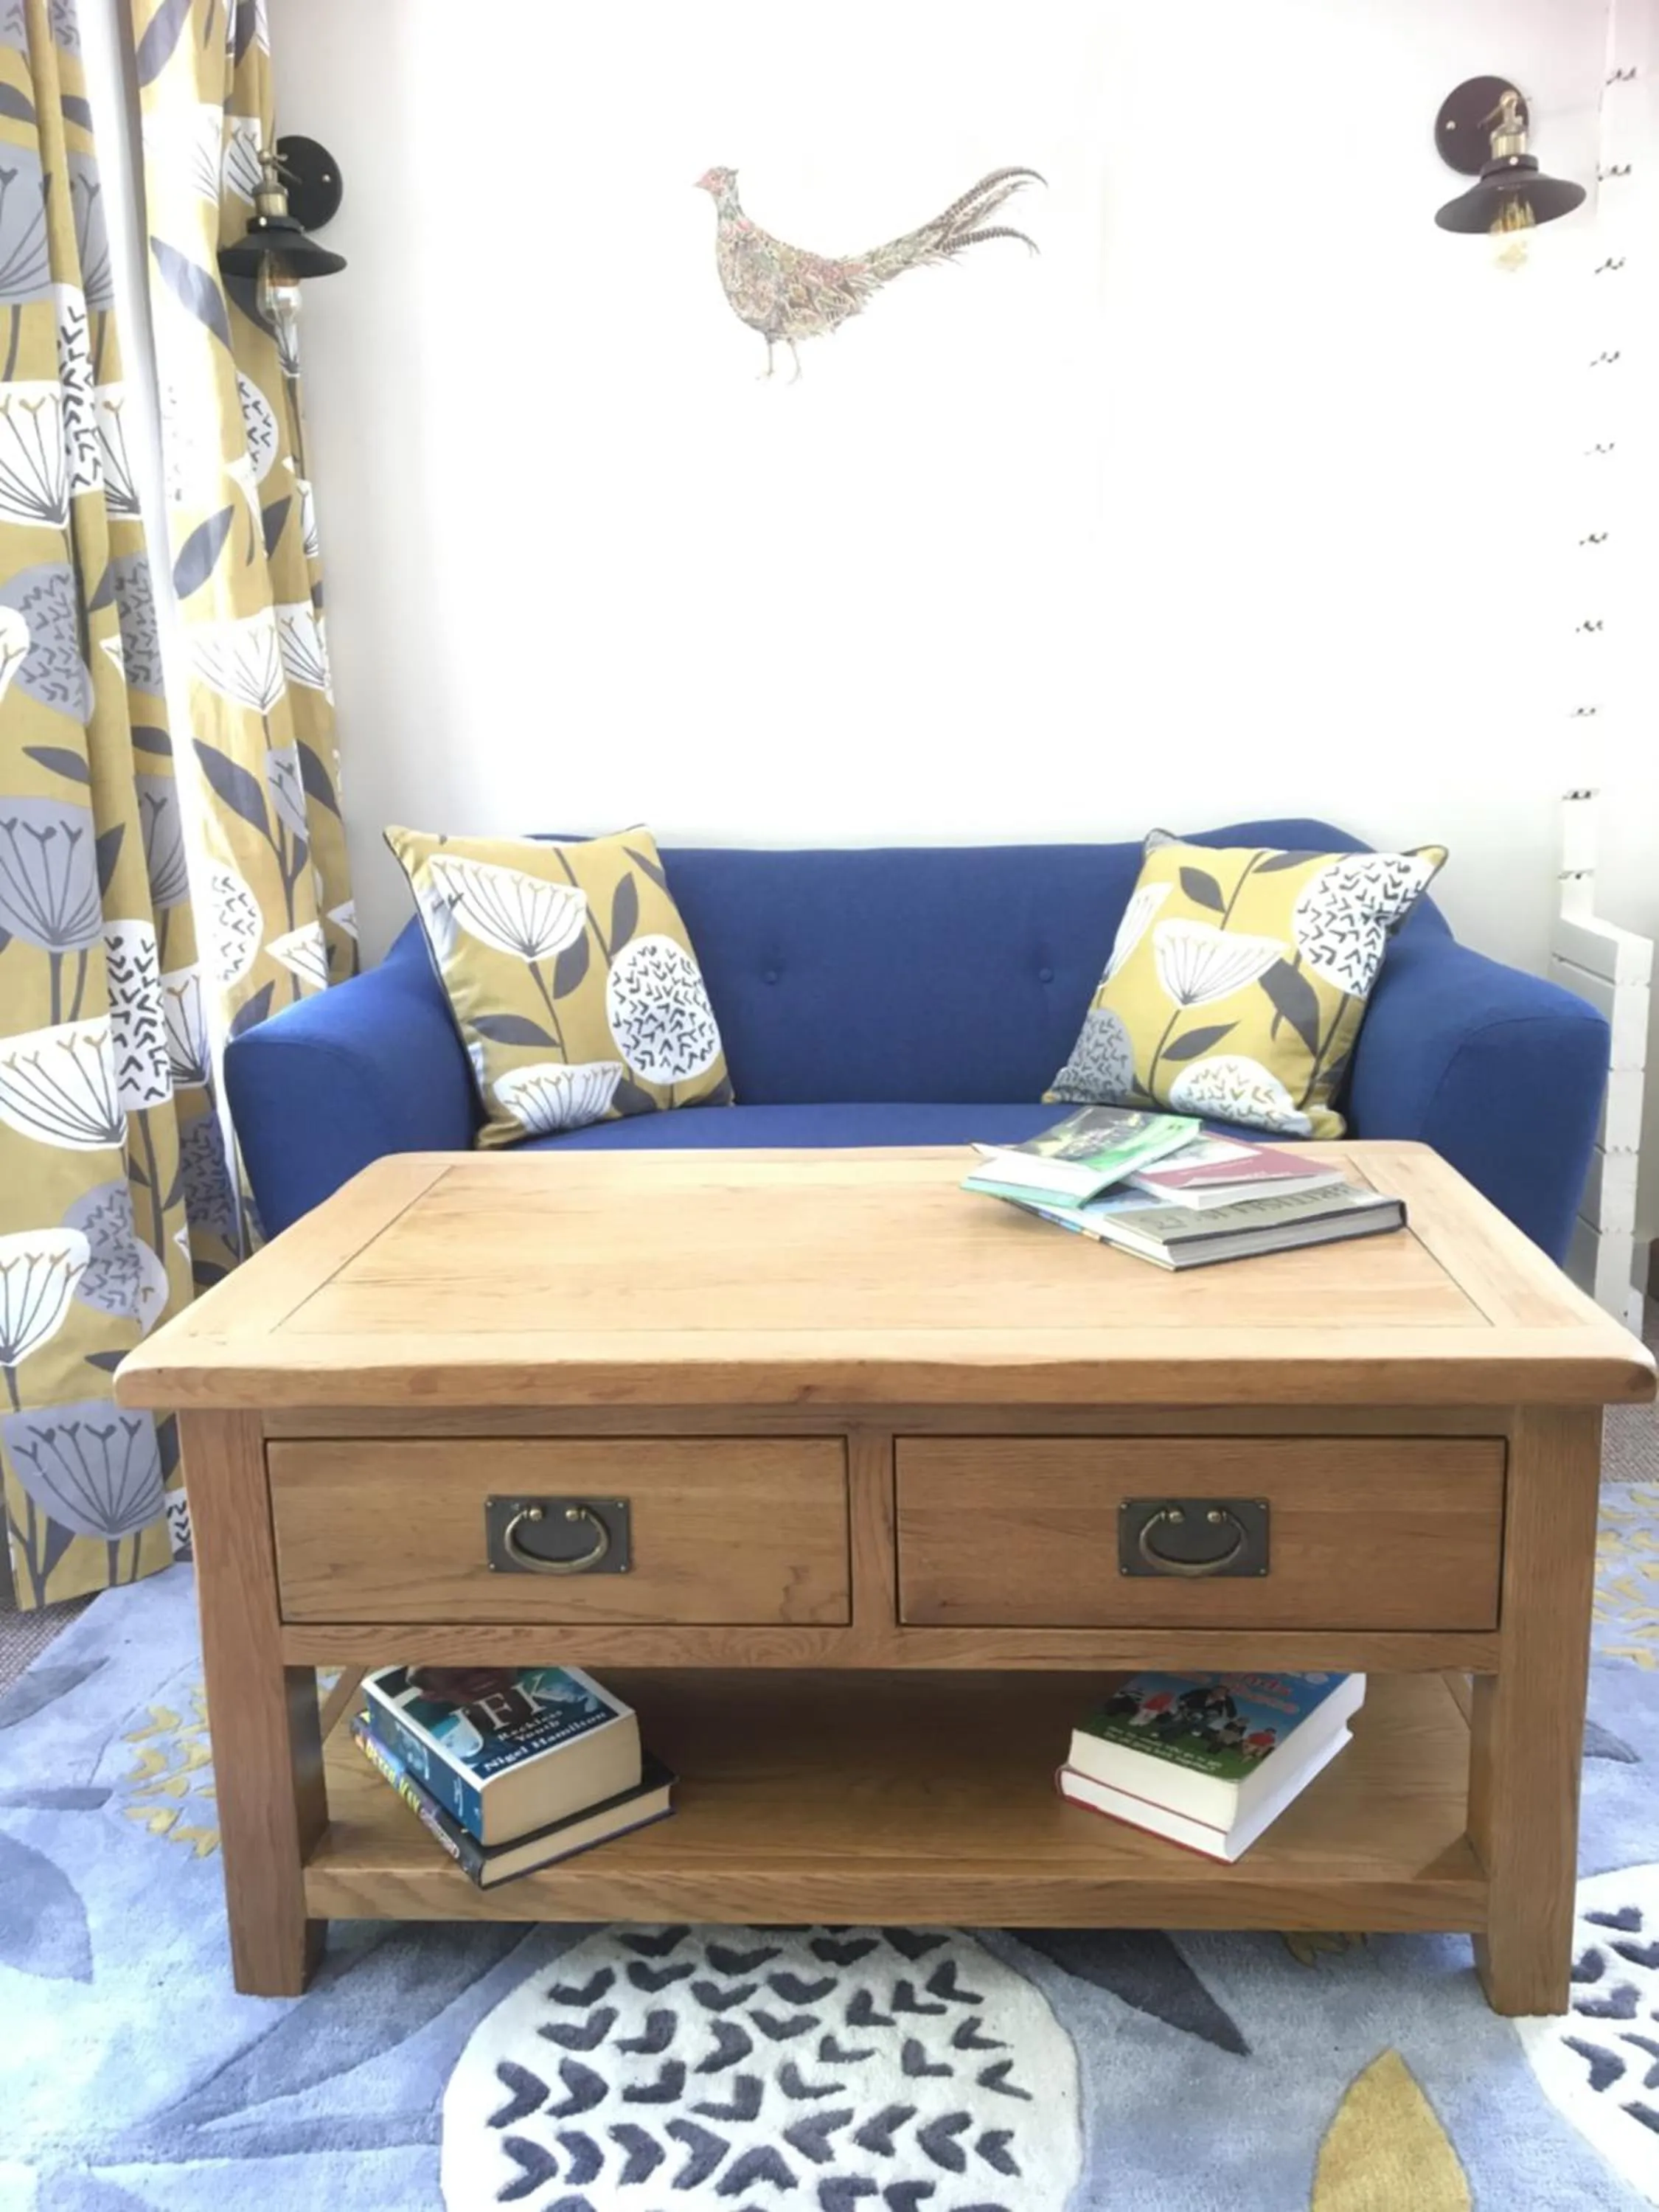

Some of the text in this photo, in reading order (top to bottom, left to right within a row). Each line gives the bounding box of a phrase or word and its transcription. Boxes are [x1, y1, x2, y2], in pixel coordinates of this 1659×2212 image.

[447, 1673, 568, 1759] JFK
[484, 1711, 607, 1773] Nigel Hamilton
[512, 1719, 560, 1742] Youth
